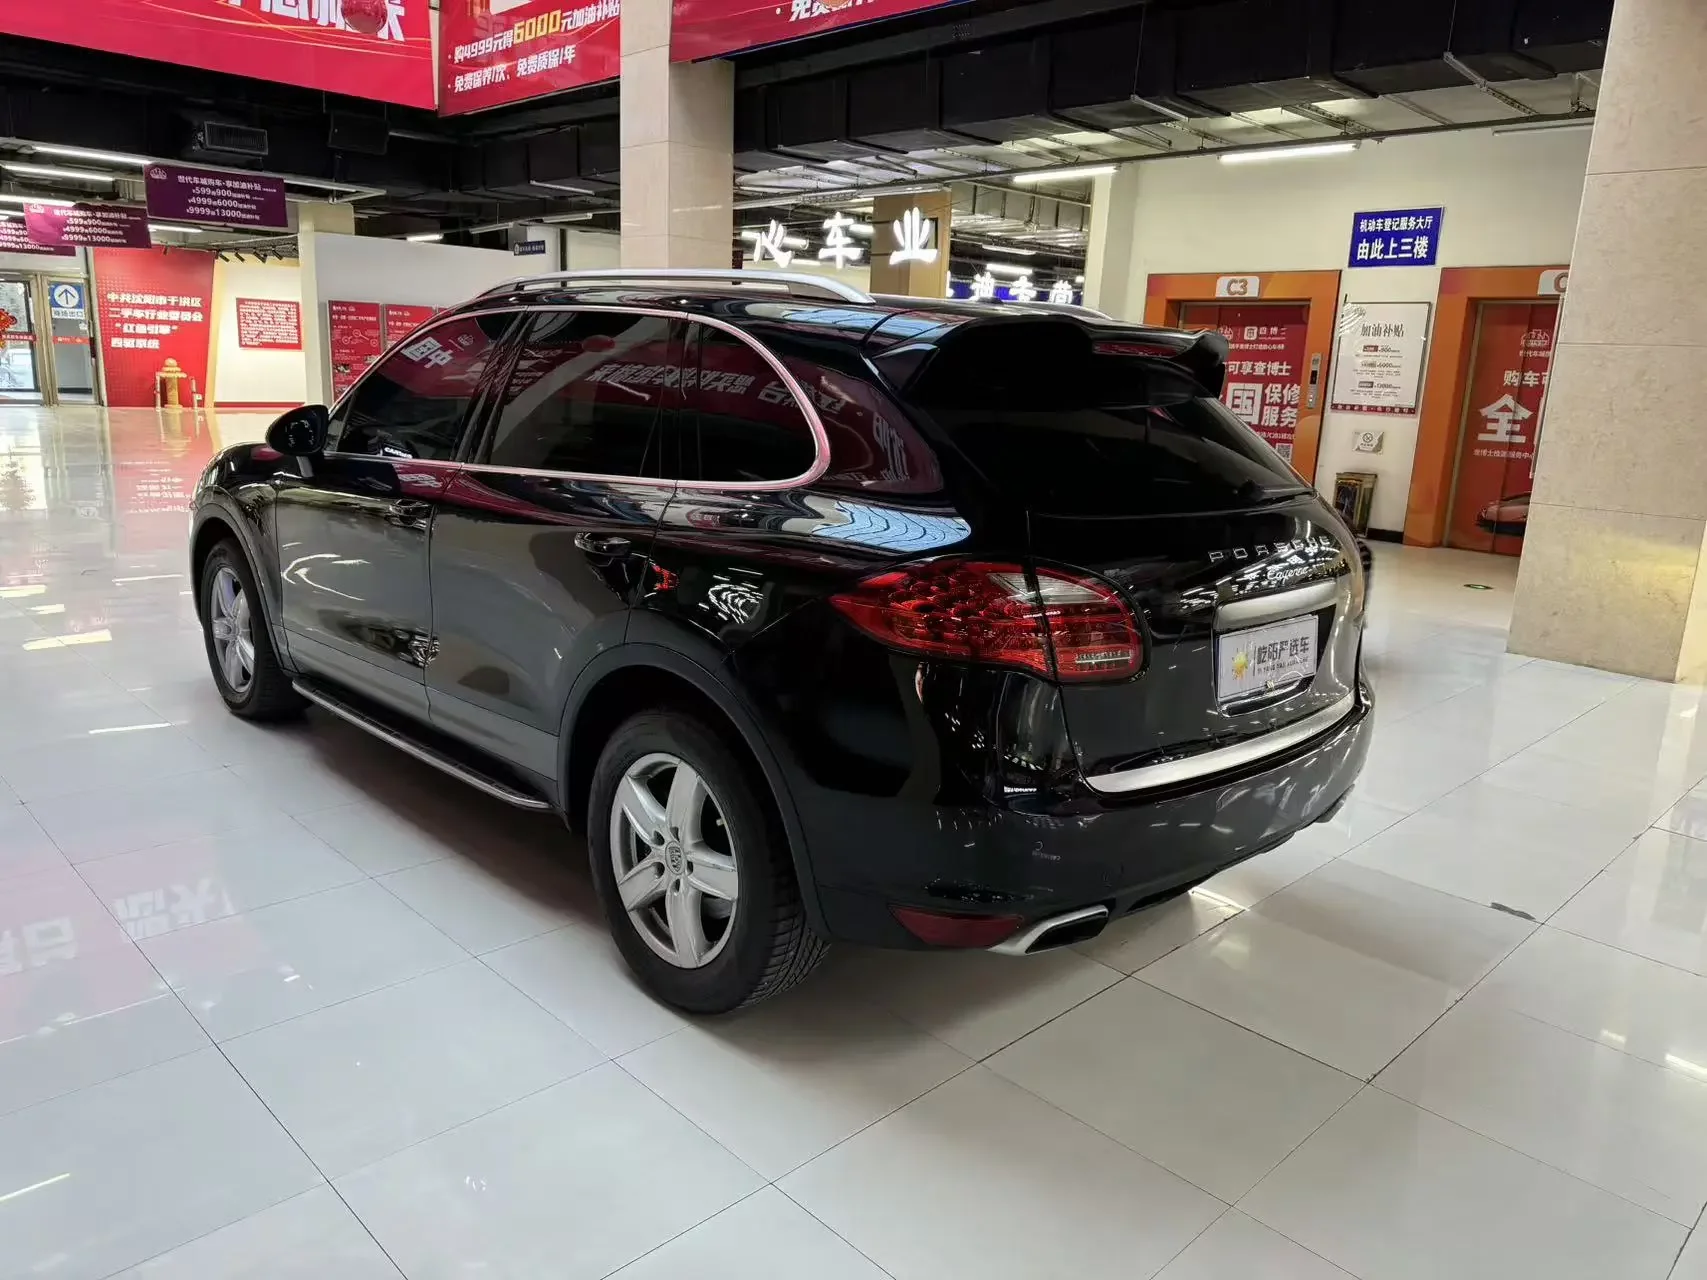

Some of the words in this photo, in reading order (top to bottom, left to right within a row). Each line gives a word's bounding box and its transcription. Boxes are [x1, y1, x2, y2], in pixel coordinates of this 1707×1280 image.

[1360, 216, 1433, 232] 机动车登记服务大厅
[1357, 236, 1429, 260] 由此上三楼
[1227, 279, 1248, 295] C3
[1361, 323, 1405, 338] 加油补贴
[1264, 383, 1301, 415] 保修
[1261, 405, 1298, 428] 服务
